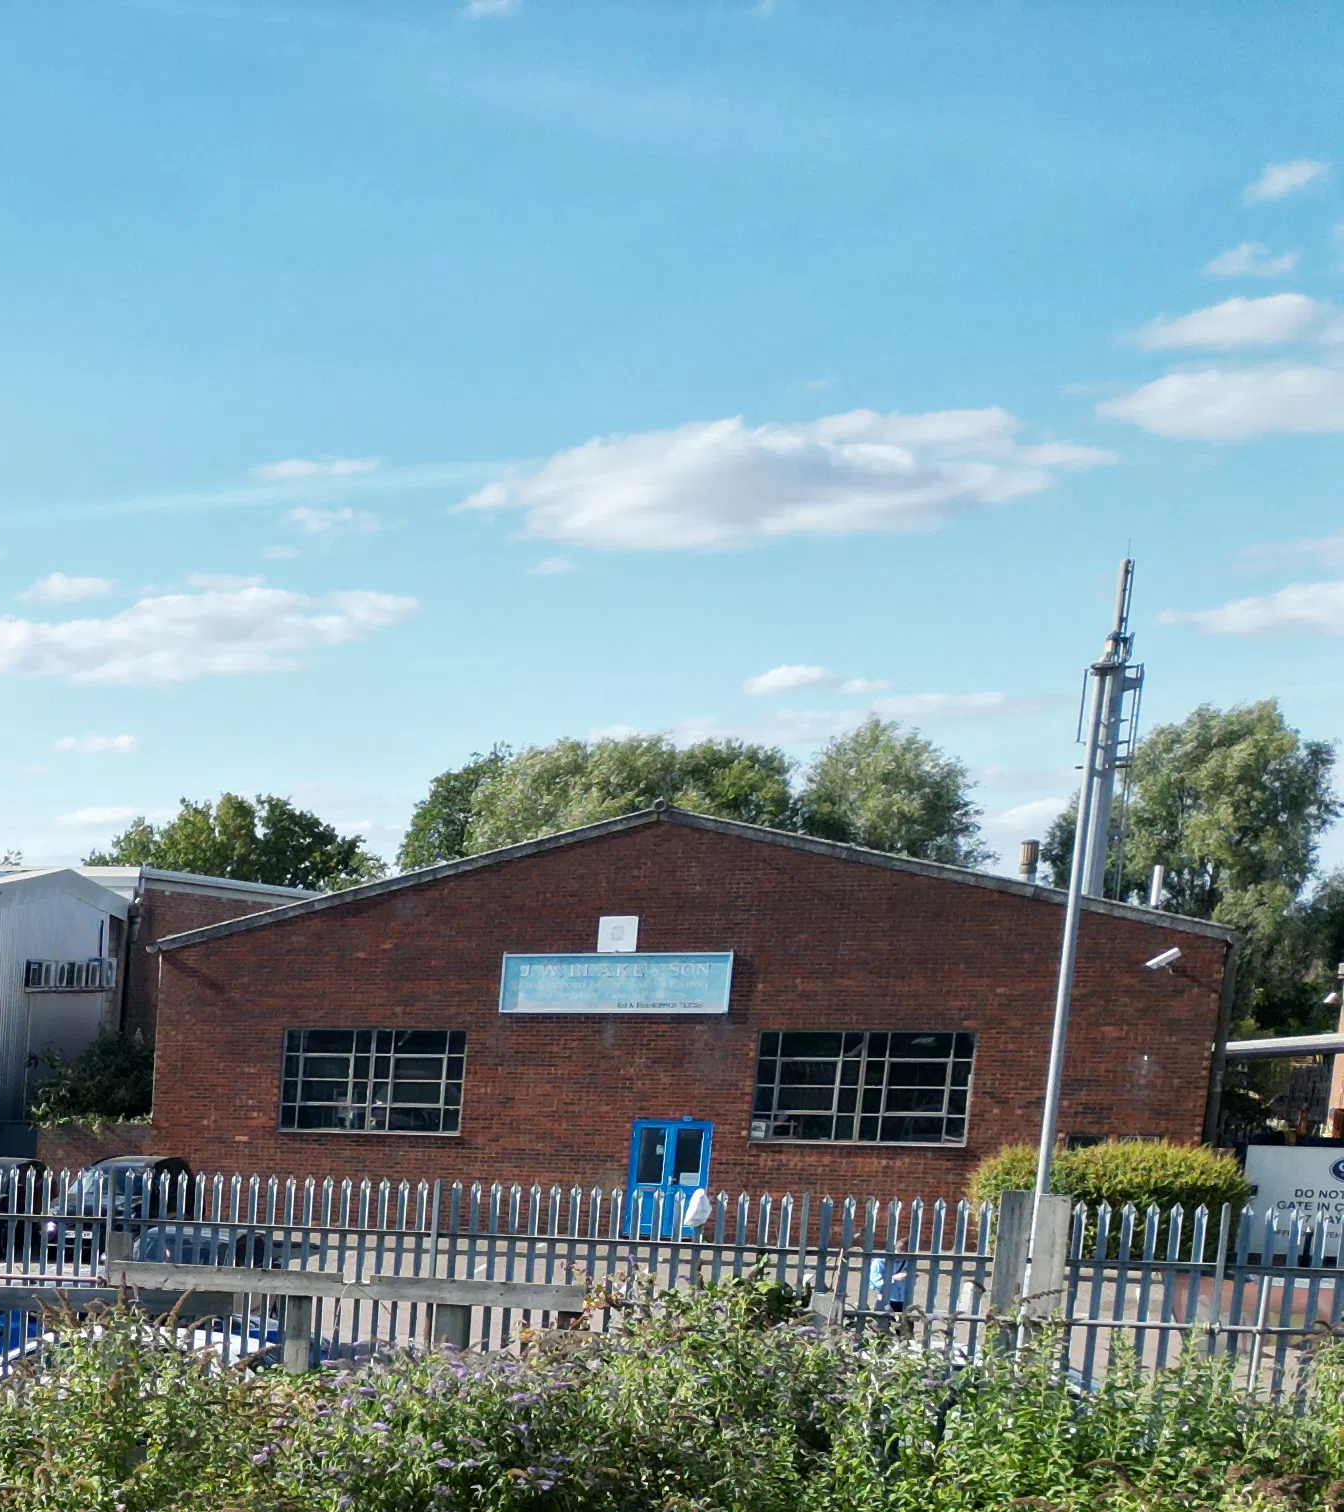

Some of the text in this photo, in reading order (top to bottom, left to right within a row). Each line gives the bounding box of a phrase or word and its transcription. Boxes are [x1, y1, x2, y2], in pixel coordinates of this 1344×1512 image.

[568, 962, 645, 978] BLAKE
[670, 962, 712, 977] SON
[1294, 1188, 1315, 1199] DO
[1276, 1200, 1313, 1212] GATE
[1316, 1202, 1330, 1212] IN
